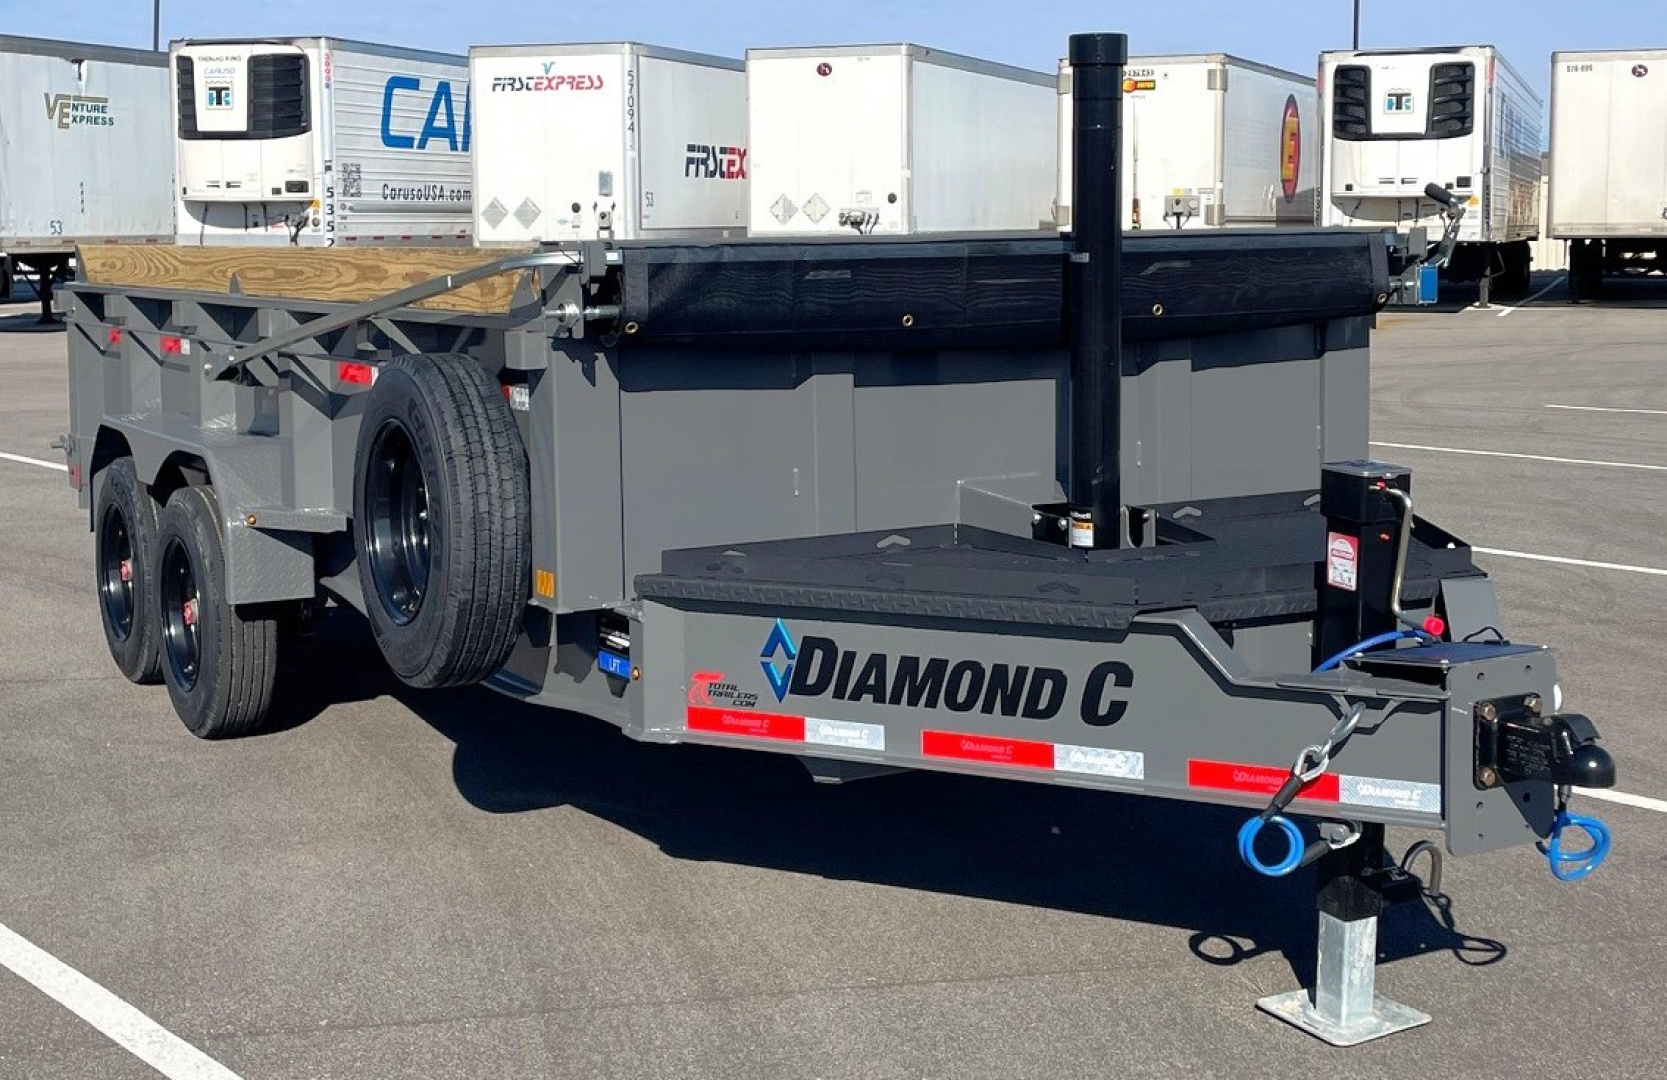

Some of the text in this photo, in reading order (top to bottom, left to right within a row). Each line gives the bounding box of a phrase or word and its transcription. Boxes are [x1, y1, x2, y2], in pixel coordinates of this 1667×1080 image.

[627, 70, 635, 132] 57094
[381, 76, 470, 151] CA
[382, 183, 472, 201] CarusoUSA.com
[50, 220, 62, 235] 53
[707, 682, 739, 691] TOTAL
[707, 690, 758, 700] TRAILERS
[1080, 660, 1134, 727] C
